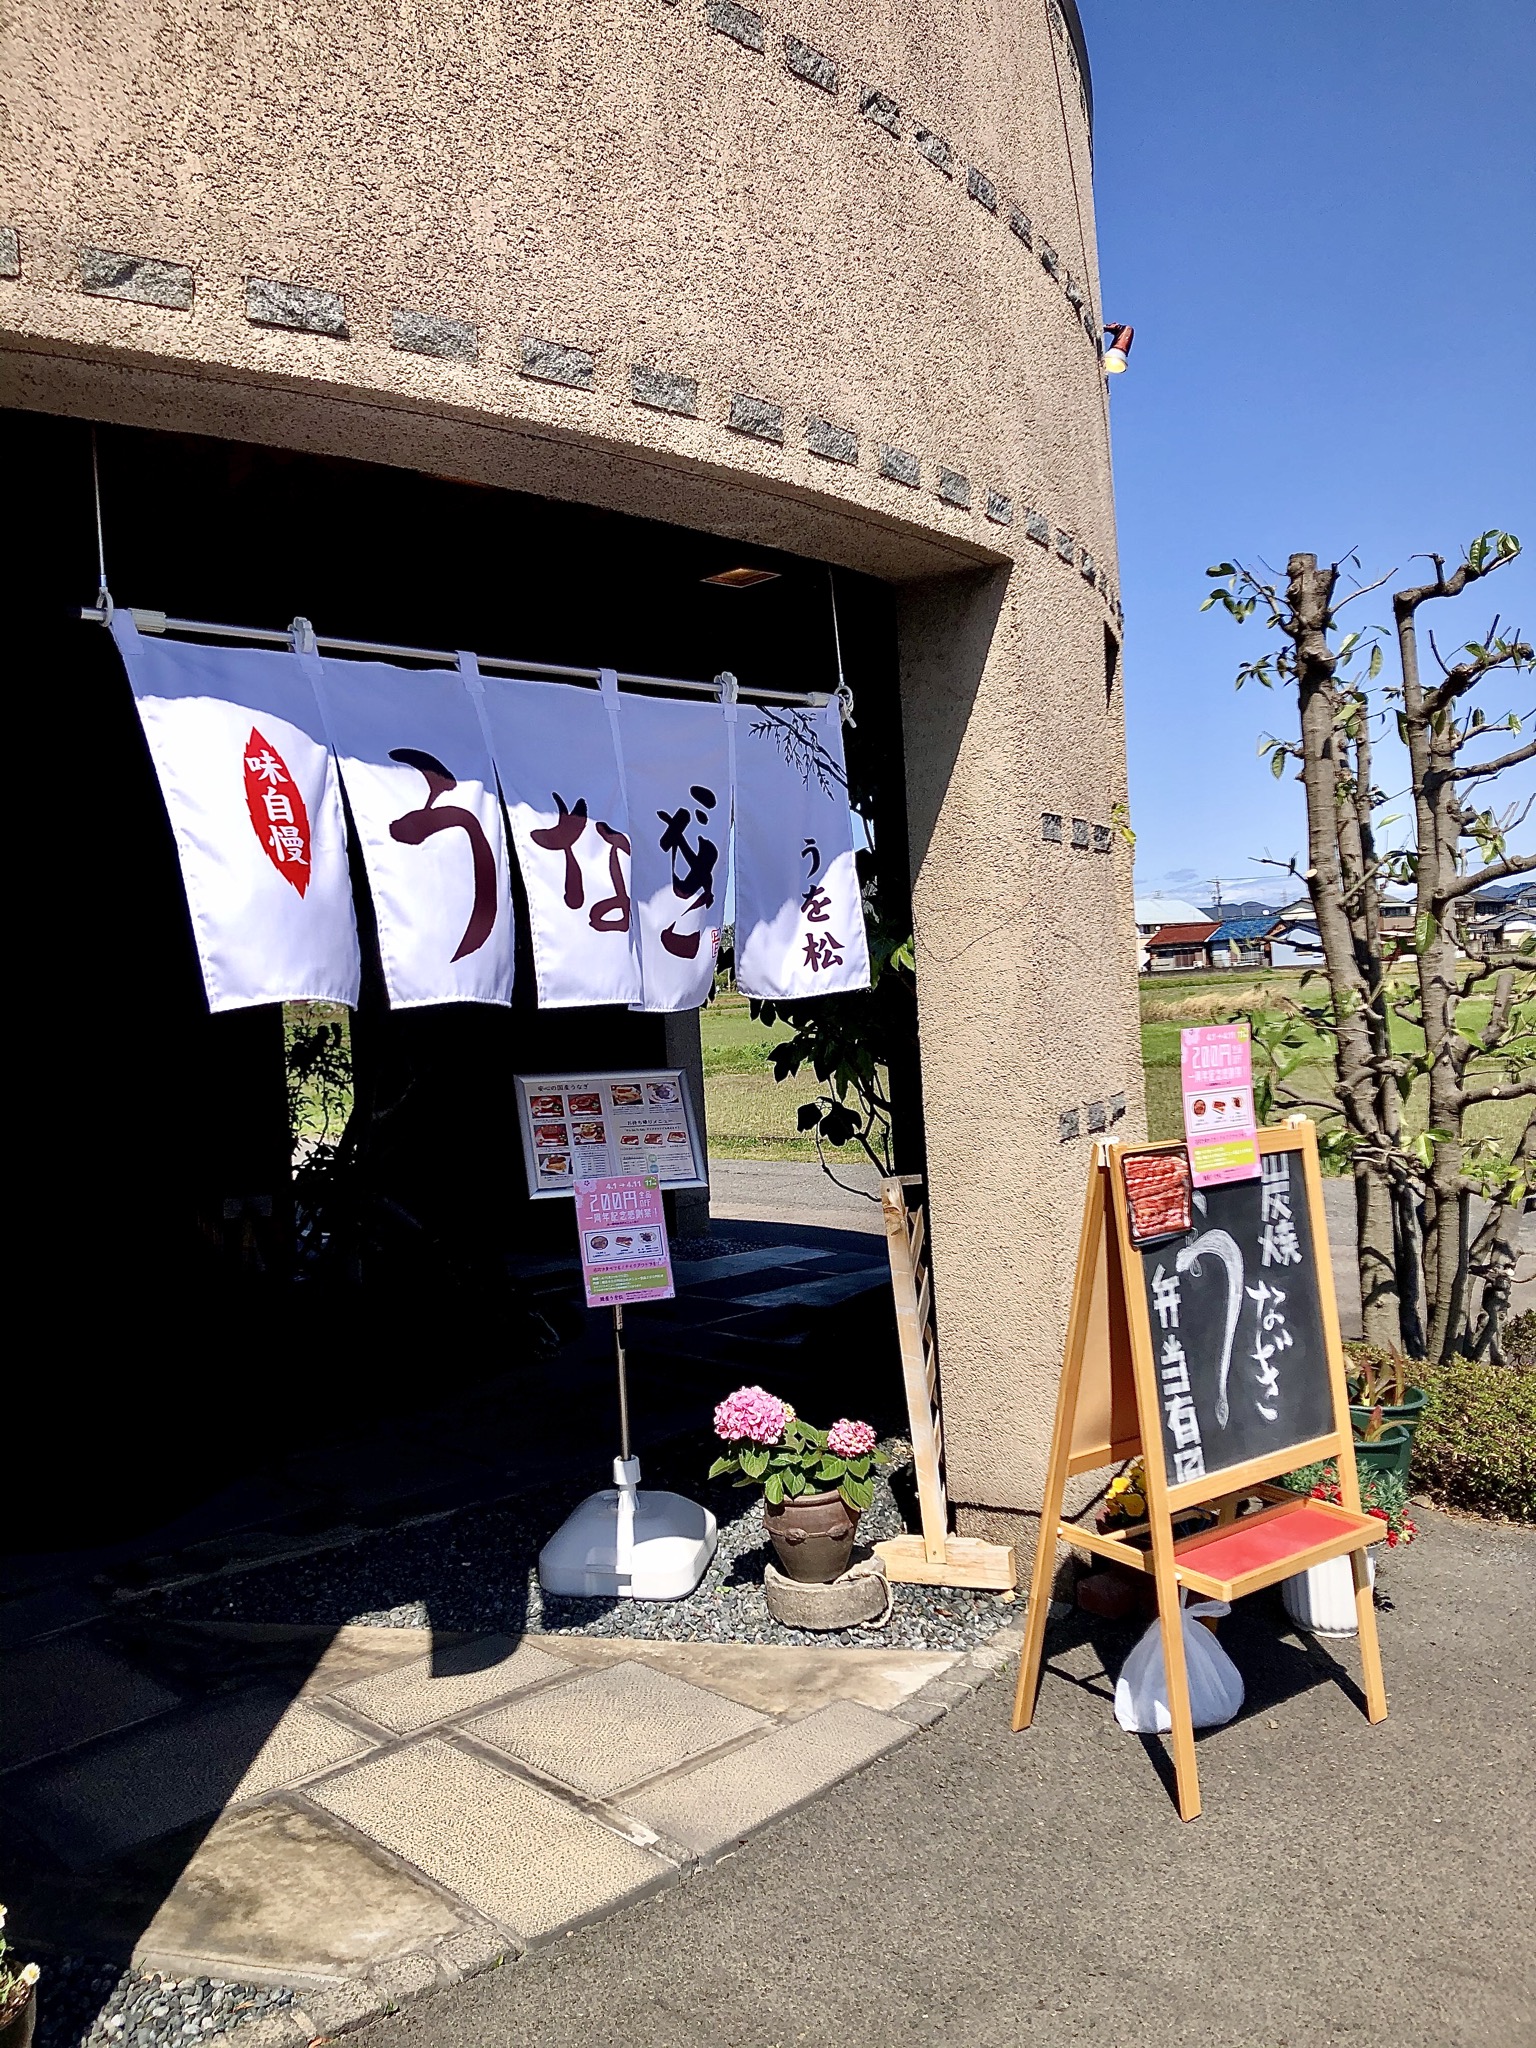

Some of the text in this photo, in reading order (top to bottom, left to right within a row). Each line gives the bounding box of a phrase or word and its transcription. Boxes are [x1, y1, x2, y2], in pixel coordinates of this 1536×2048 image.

[245, 749, 309, 867] 味自慢
[387, 747, 719, 964] うなぎ
[800, 837, 845, 973] うを松
[589, 1190, 638, 1212] 200円
